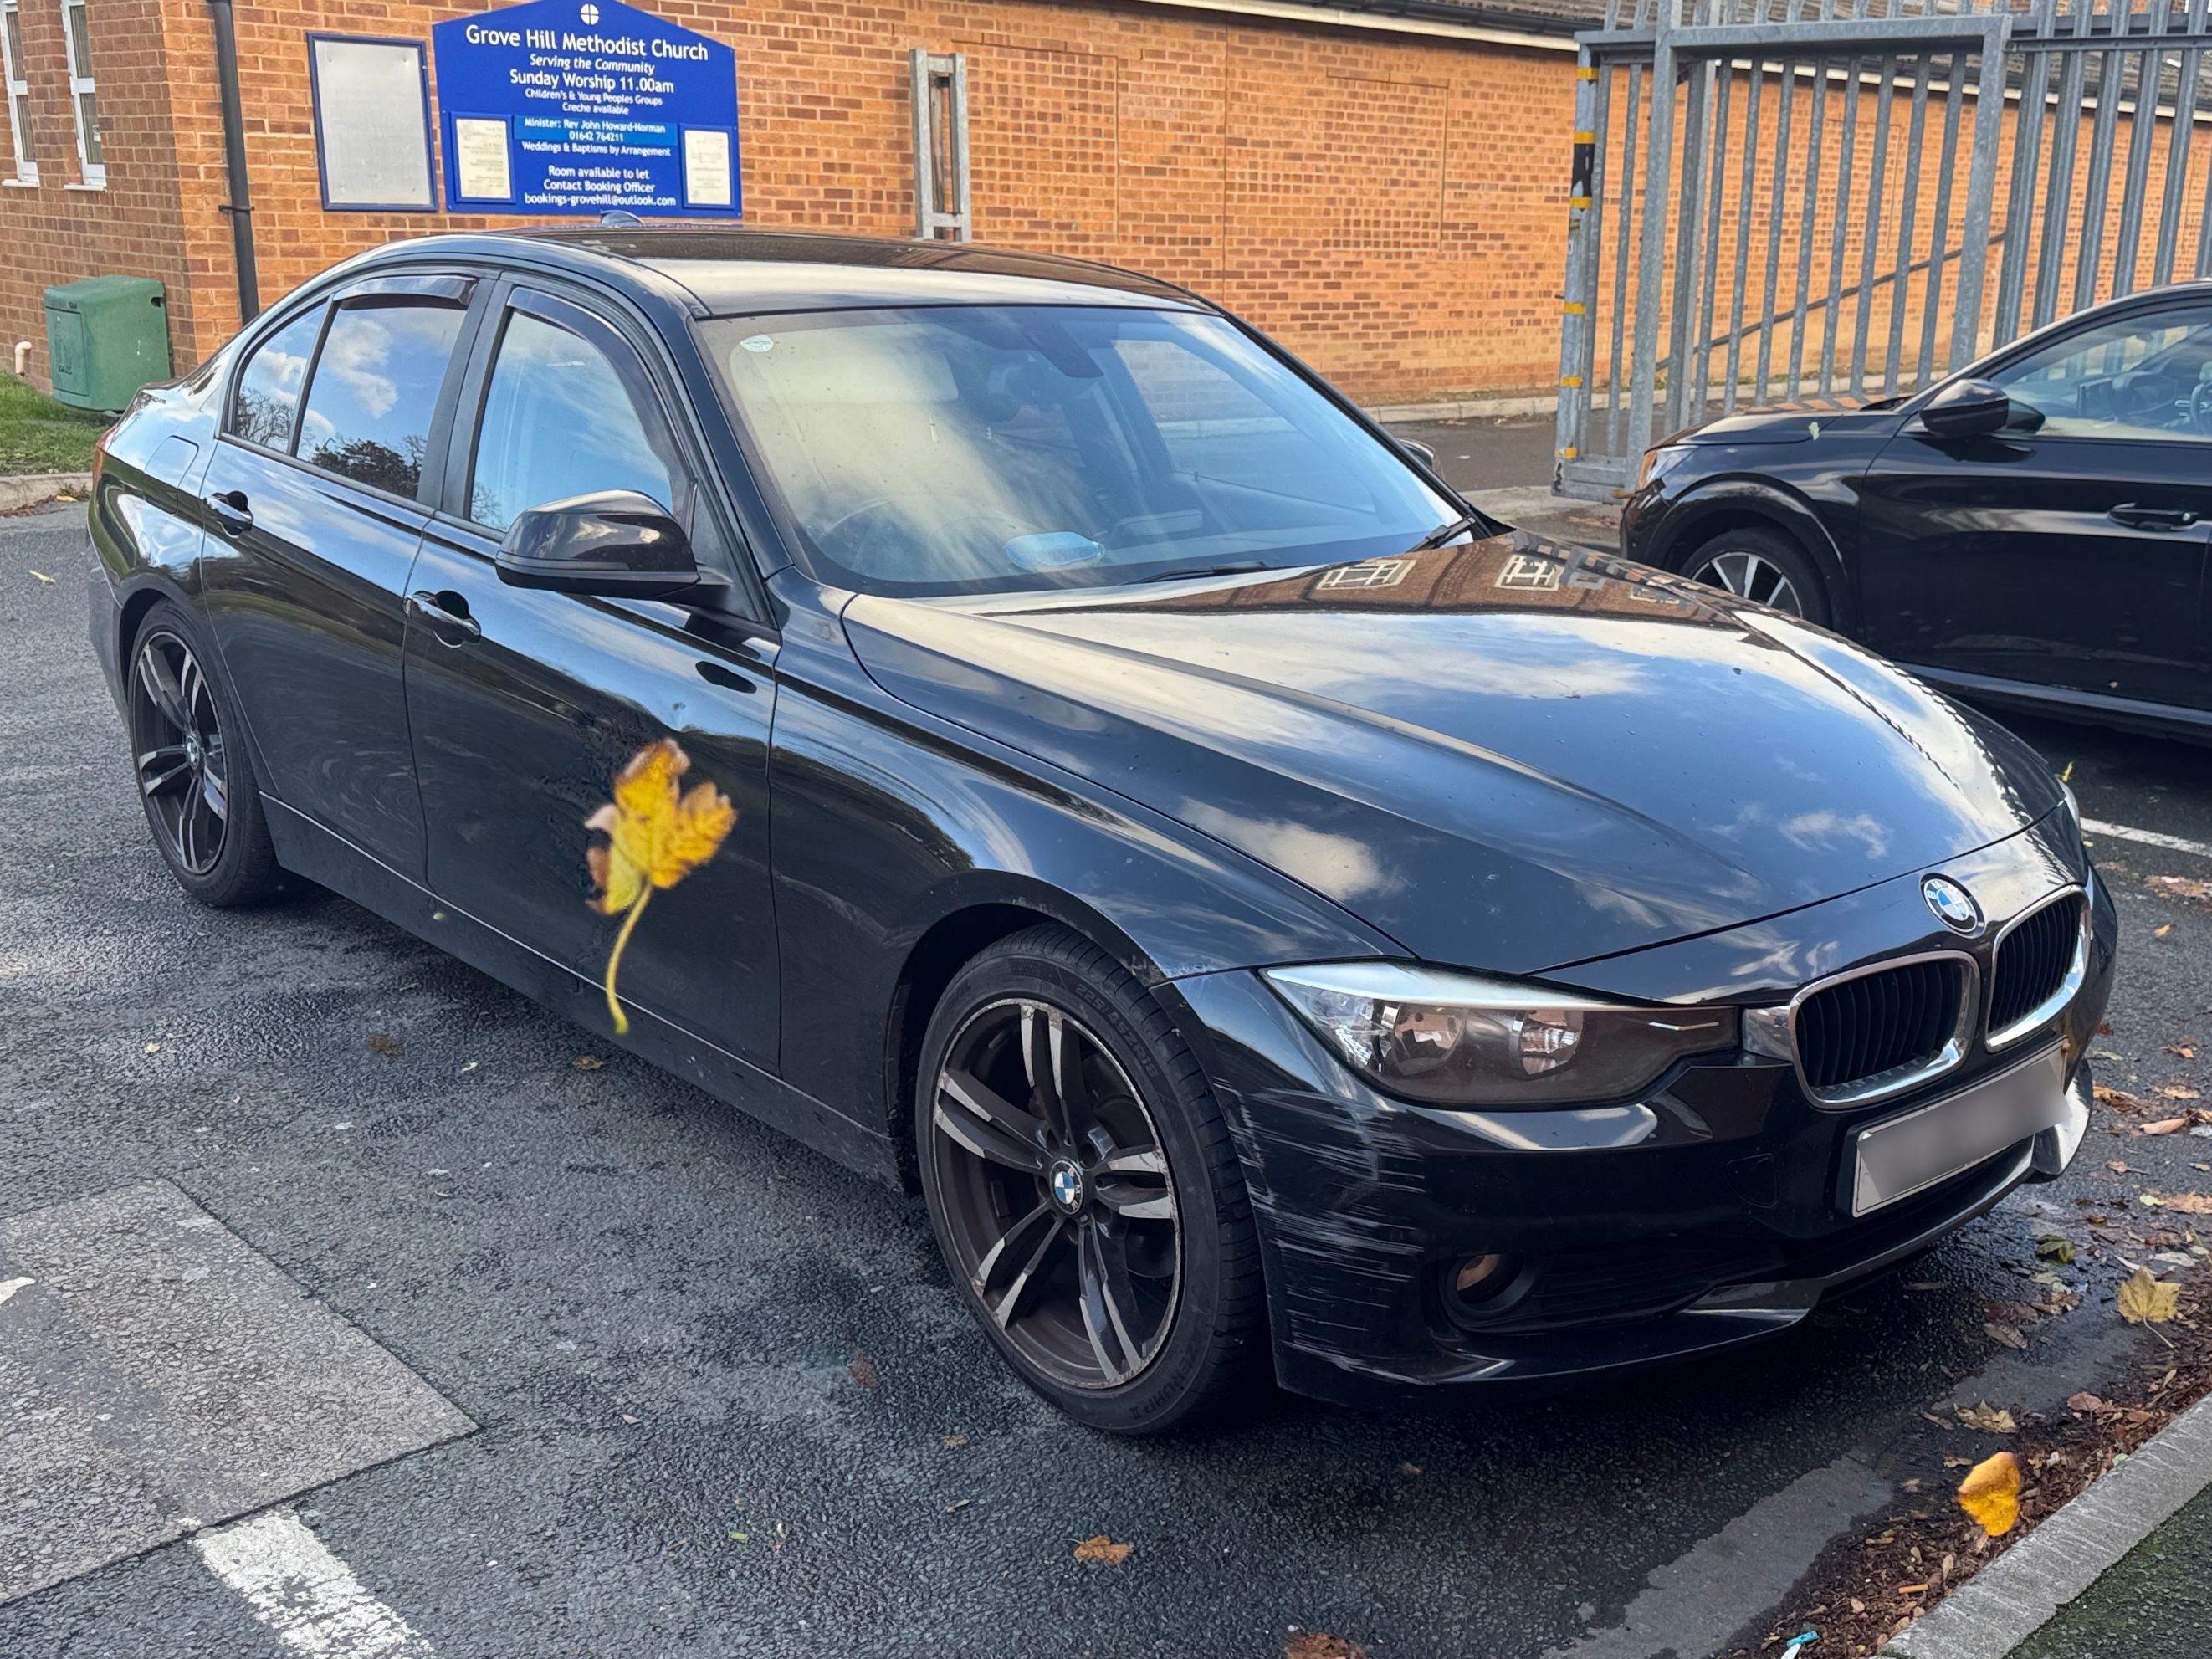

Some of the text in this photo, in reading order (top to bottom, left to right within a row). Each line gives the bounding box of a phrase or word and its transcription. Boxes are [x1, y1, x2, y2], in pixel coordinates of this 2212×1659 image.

[466, 24, 709, 60] Grove Hill Methodist Church
[530, 53, 655, 76] Serving the Community
[509, 69, 674, 94] Sunday Worship 11.00am
[525, 88, 663, 107] Children's & Young Peoples Groups
[562, 101, 629, 115] Creche available
[525, 117, 666, 134] Minister: Rev John Howard-Norman
[569, 131, 624, 142] 01642 764211
[522, 141, 671, 157] Weddings & Baptisms by Arrangement
[549, 164, 650, 180] Room available to let
[543, 178, 656, 194] Contact Booking Officer
[524, 192, 677, 207] bookings-grovehill@outlook.com
